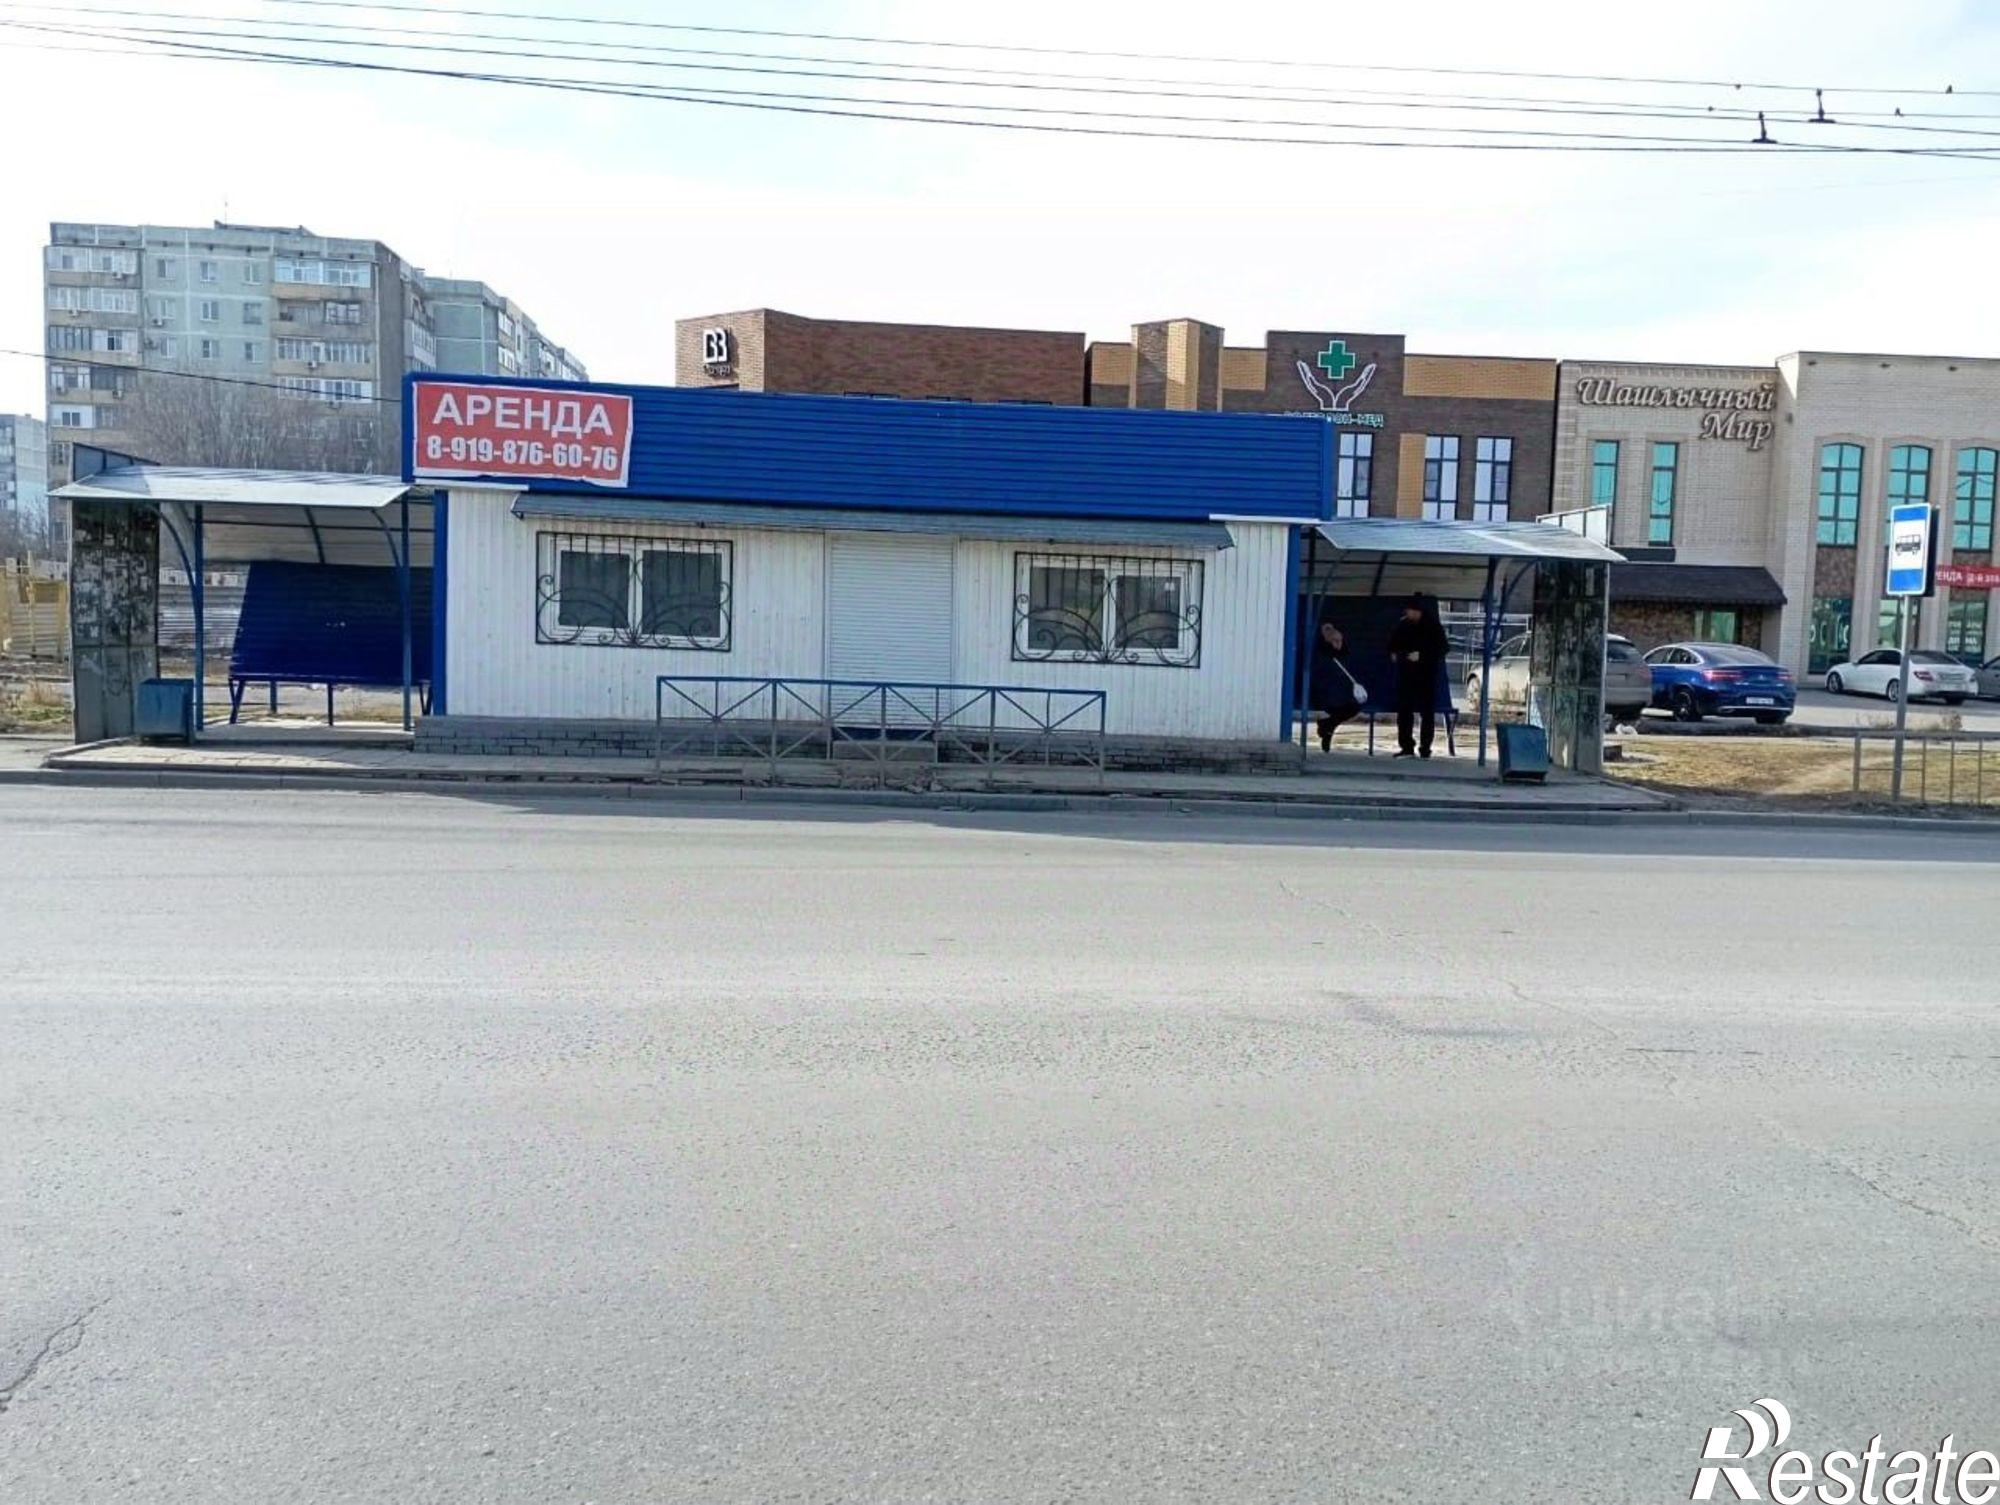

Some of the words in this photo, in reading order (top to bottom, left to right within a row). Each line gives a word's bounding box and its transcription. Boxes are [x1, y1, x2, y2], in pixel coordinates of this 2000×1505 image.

[1577, 377, 1776, 411] Шашлычный
[432, 393, 614, 440] АРЕНДА
[1700, 410, 1773, 451] Мир
[427, 435, 618, 472] 8-919-876-60-76
